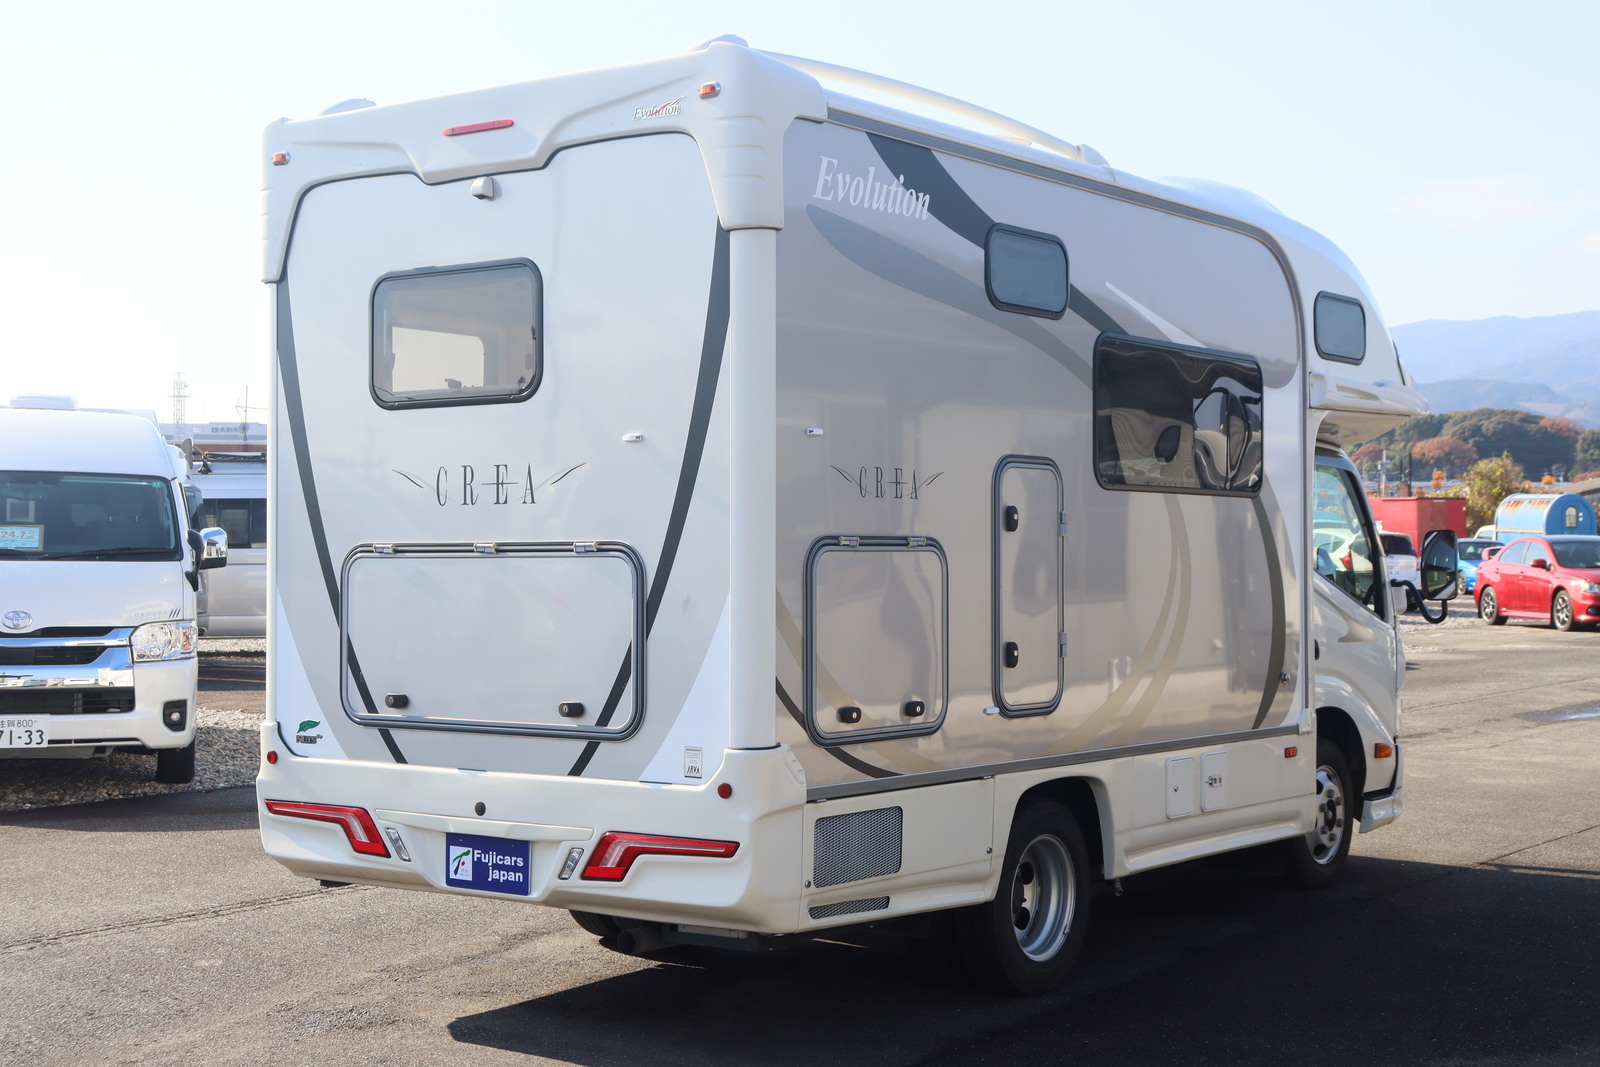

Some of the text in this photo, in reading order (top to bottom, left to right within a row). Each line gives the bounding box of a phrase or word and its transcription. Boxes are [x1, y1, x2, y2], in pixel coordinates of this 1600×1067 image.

[633, 104, 682, 120] Evolution
[812, 155, 931, 221] Evolution
[436, 463, 537, 507] CREA
[859, 465, 918, 500] CREA
[473, 849, 524, 867] Fujicars
[487, 866, 523, 883] japan
